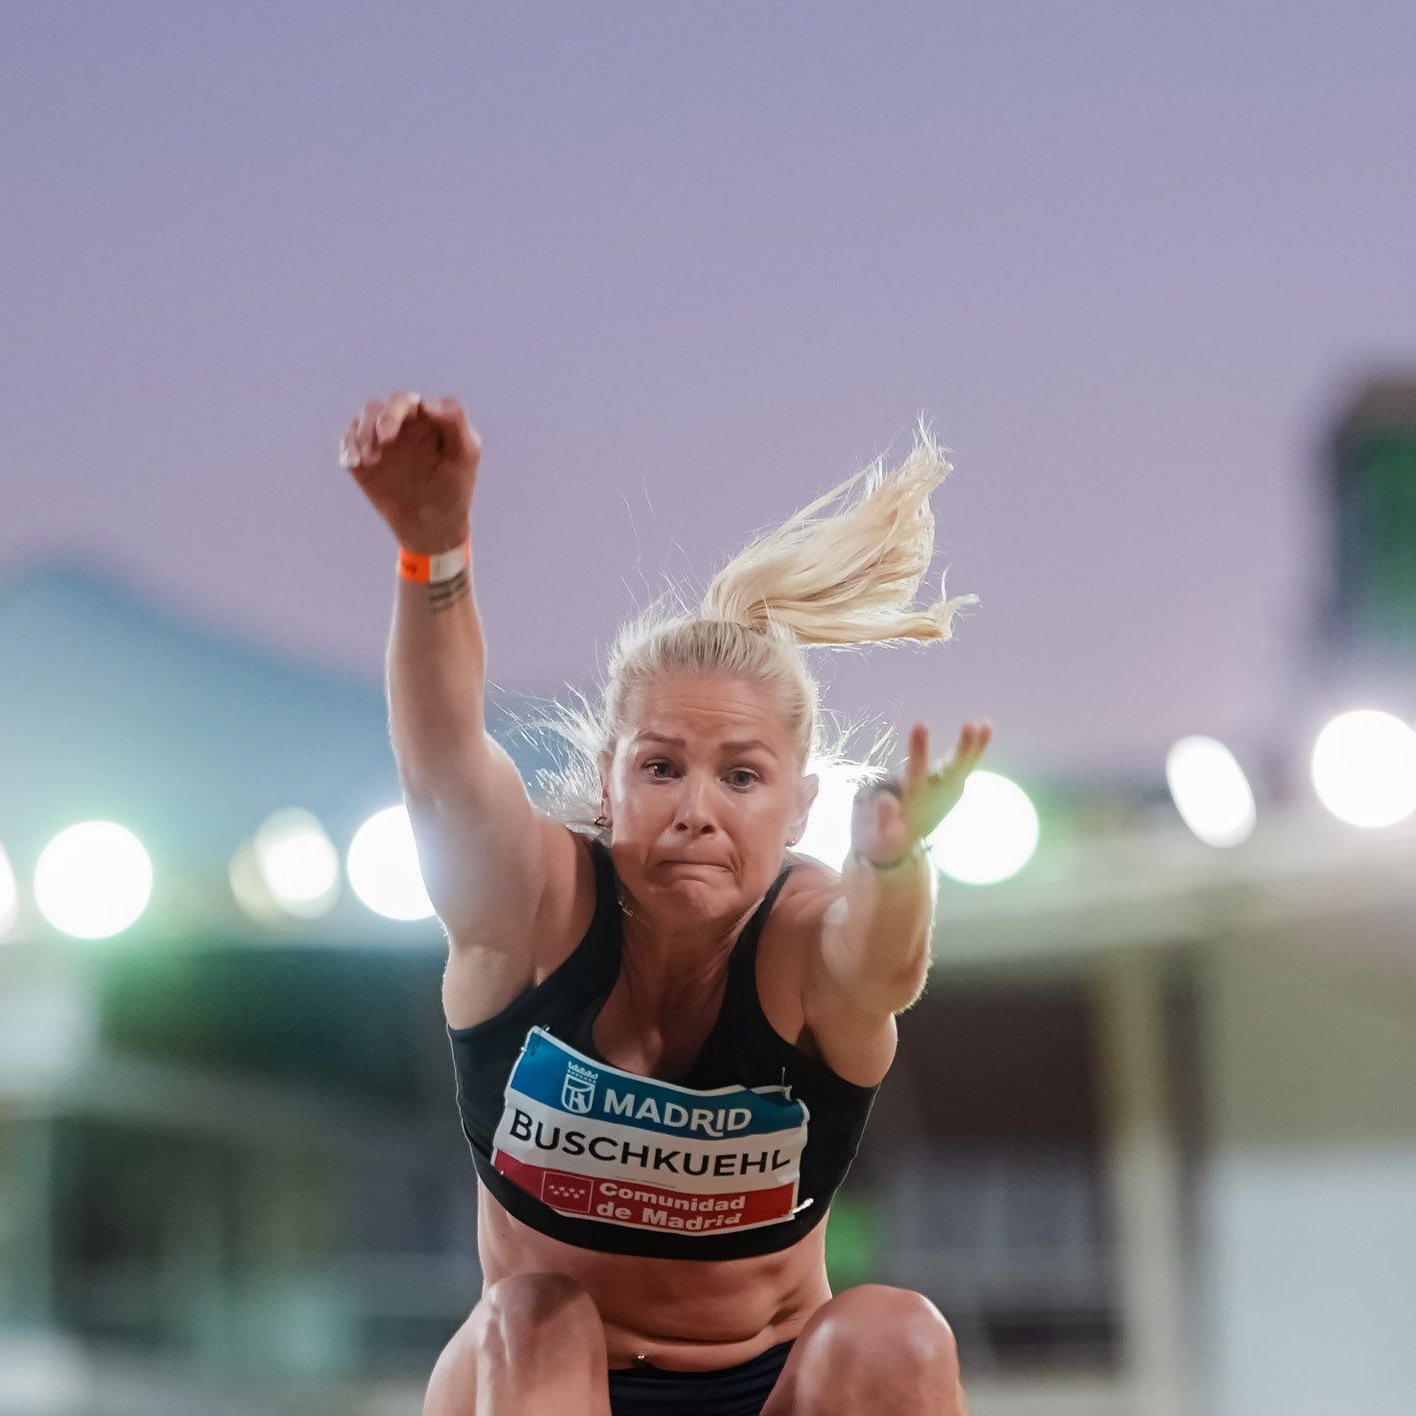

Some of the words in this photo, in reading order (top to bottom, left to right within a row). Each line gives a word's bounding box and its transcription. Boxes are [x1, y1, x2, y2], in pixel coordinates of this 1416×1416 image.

[603, 1088, 752, 1137] MADRID
[510, 1109, 791, 1177] BUSCHKUEHL
[596, 1201, 632, 1220] de
[641, 1209, 743, 1231] Madrid
[599, 1182, 746, 1212] Comunidad
